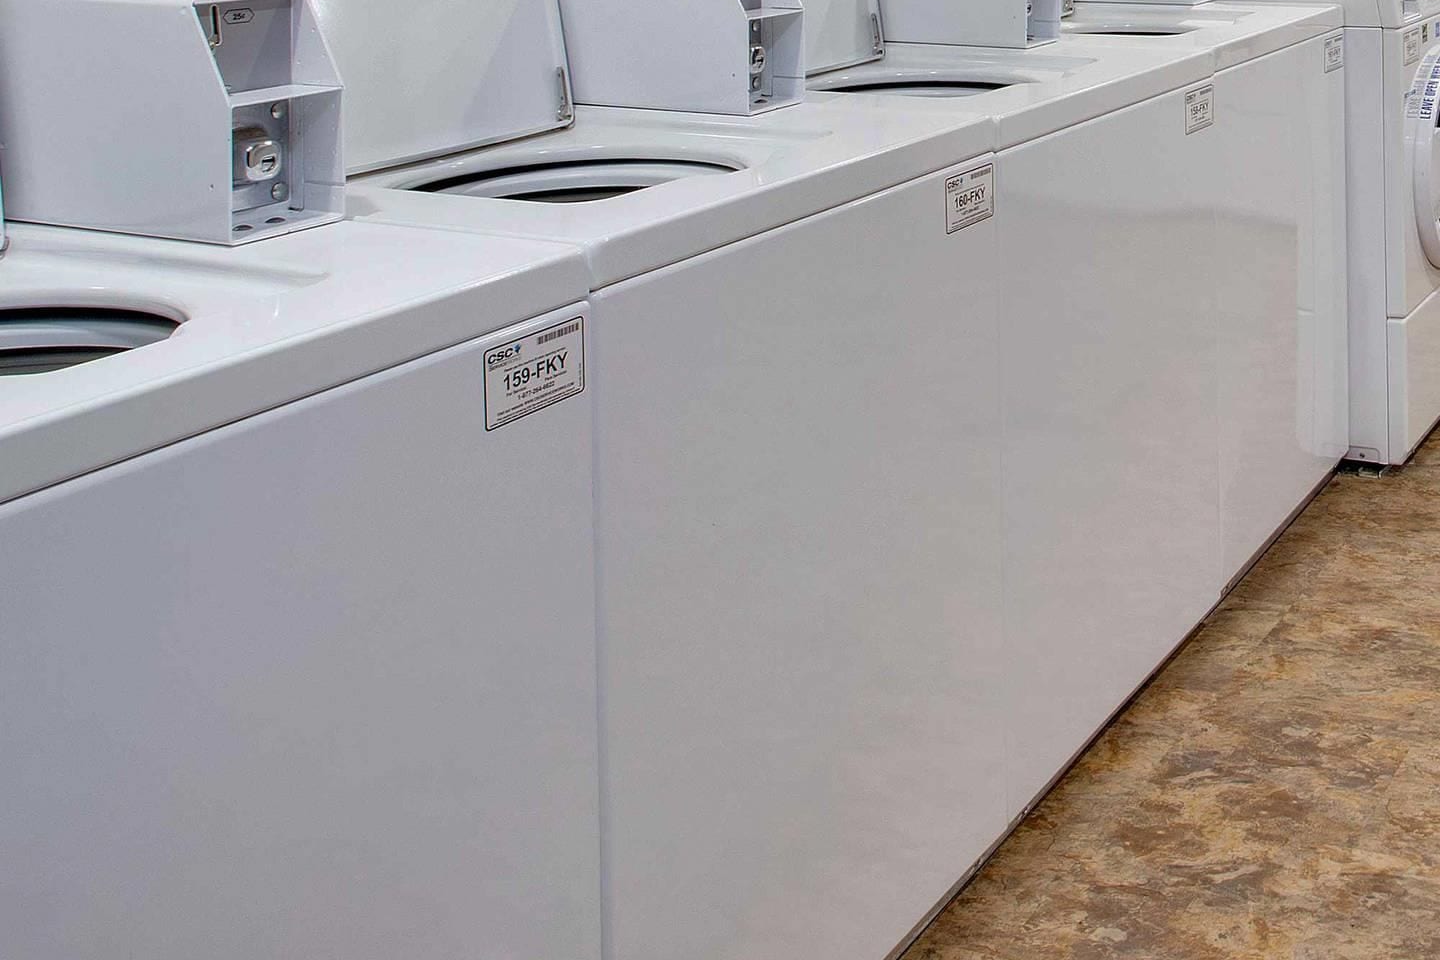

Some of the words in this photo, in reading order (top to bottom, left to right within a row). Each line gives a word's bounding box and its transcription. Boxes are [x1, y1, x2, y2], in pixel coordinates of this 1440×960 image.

[1424, 80, 1439, 96] OPEN
[1420, 98, 1434, 120] LEAVE
[948, 179, 960, 190] CSC
[954, 186, 986, 208] 160-FKY
[488, 347, 514, 364] CSC
[503, 351, 568, 391] 159-FKY
